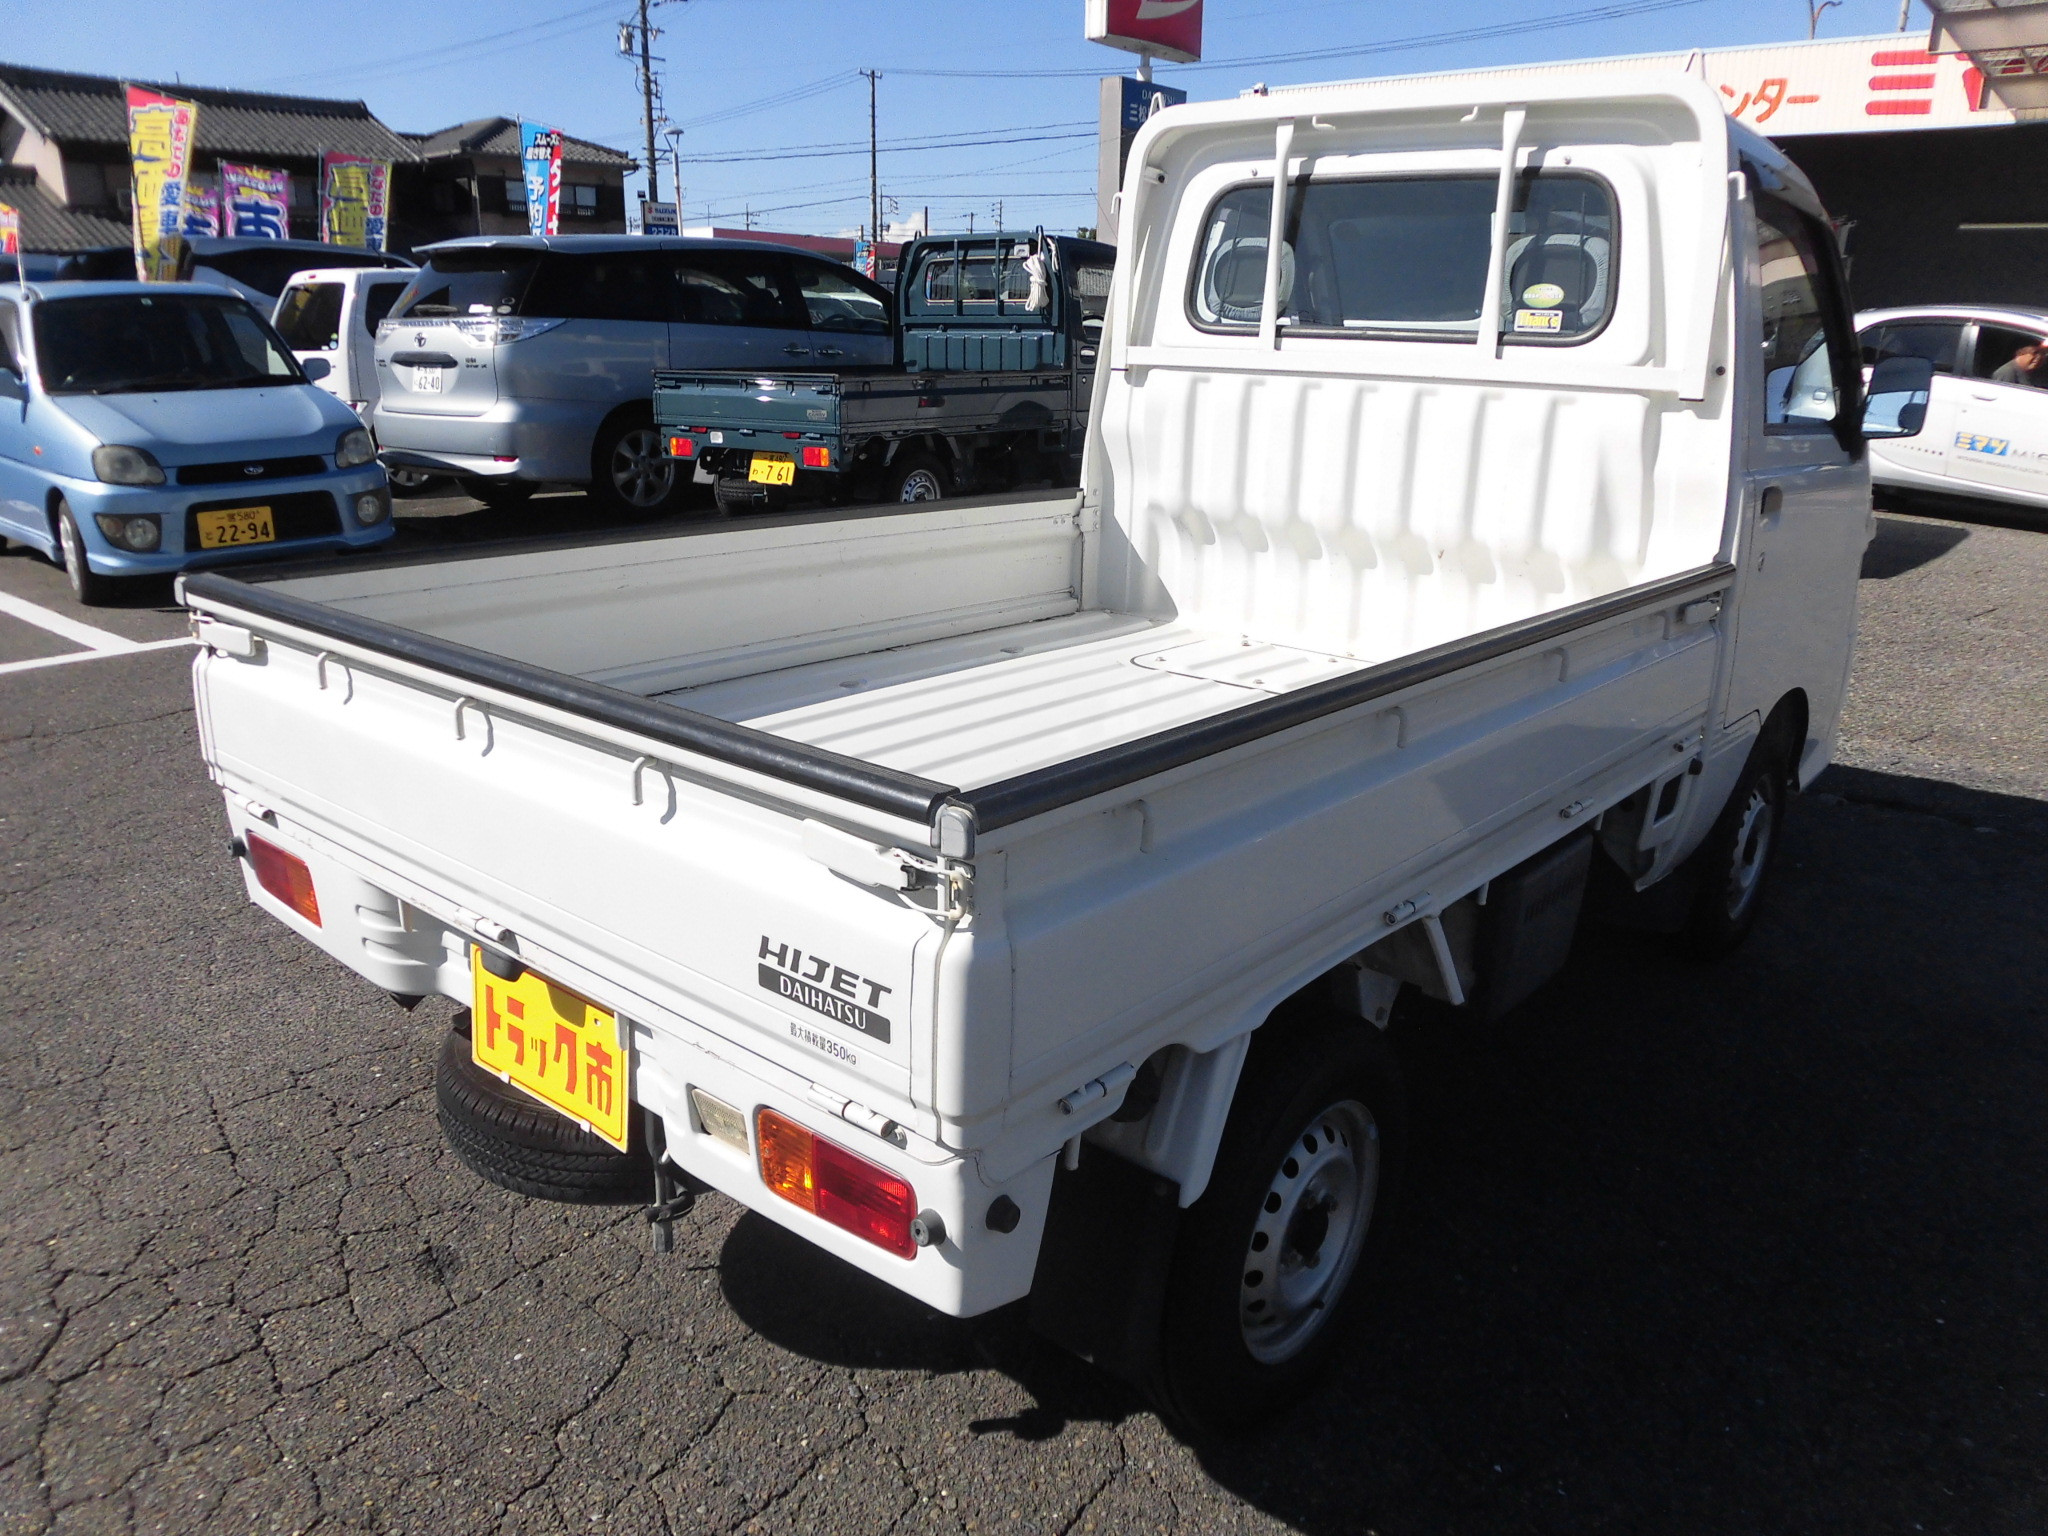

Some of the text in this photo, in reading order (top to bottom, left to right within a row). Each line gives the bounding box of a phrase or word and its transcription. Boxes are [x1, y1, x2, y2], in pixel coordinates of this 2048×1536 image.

[1142, 89, 1175, 105] DATSU
[225, 172, 285, 193] WELCOME
[216, 521, 270, 543] 22-94
[758, 935, 892, 1009] HIJET
[780, 975, 866, 1030] DAIHATSU
